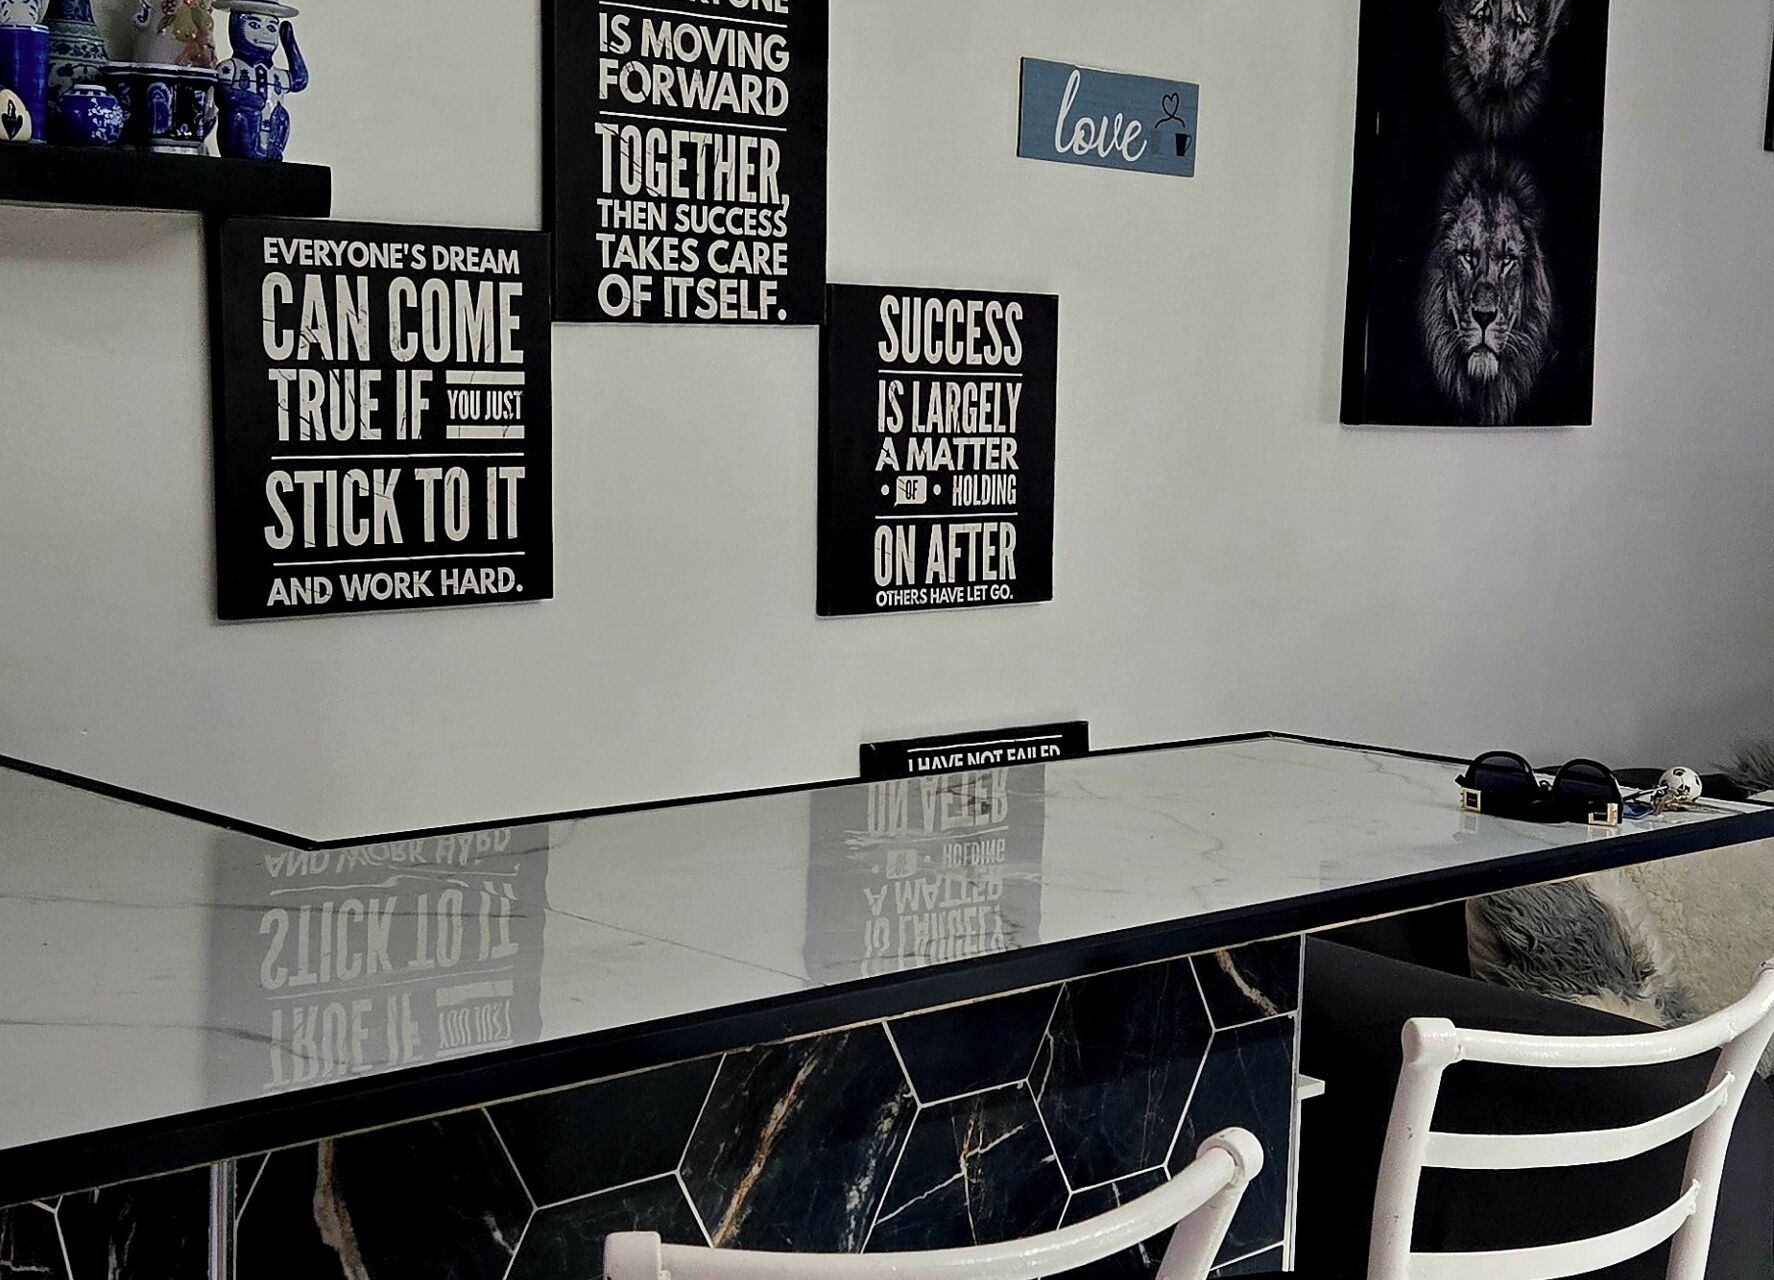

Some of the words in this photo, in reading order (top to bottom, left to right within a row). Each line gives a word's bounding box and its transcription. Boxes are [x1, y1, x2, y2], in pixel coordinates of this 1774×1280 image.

[599, 12, 632, 54] IS
[640, 18, 790, 73] MOVING
[599, 58, 789, 117] FORWARD
[1054, 69, 1148, 162] love
[594, 122, 790, 216] TOGETHER,
[596, 198, 667, 232] THEN
[673, 203, 788, 238] SUCCESS
[263, 236, 426, 271] EVERYONE'S
[432, 245, 520, 275] DREAM
[595, 232, 699, 272] TAKES
[707, 240, 788, 276] CARE
[261, 271, 370, 362] CAN
[388, 276, 524, 363] COME
[597, 273, 653, 318] OF
[663, 276, 788, 322] ITSELF.
[877, 294, 1023, 366] SUCCESS
[268, 368, 382, 442] TRUE
[395, 369, 433, 440] IF
[446, 389, 480, 420] YOU
[484, 389, 523, 420] JUST
[877, 379, 904, 434] IS
[911, 380, 1023, 434] LARGELY
[875, 436, 900, 472] A
[906, 436, 1019, 472] MATTER
[264, 468, 403, 550] STICK
[413, 465, 470, 543] TO
[486, 465, 526, 541] IT
[905, 479, 919, 501] OF
[951, 473, 1018, 507] HOLDING
[873, 523, 915, 587] ON
[924, 521, 1017, 585] AFTER
[266, 575, 333, 607] AND
[339, 569, 433, 602] WORK
[439, 567, 524, 596] HARD.
[875, 588, 928, 607] OTHERS
[929, 586, 965, 605] HAVE
[966, 584, 989, 602] LET
[989, 583, 1014, 600] GO.
[917, 753, 964, 771] HAVE
[967, 749, 1003, 766] NOT
